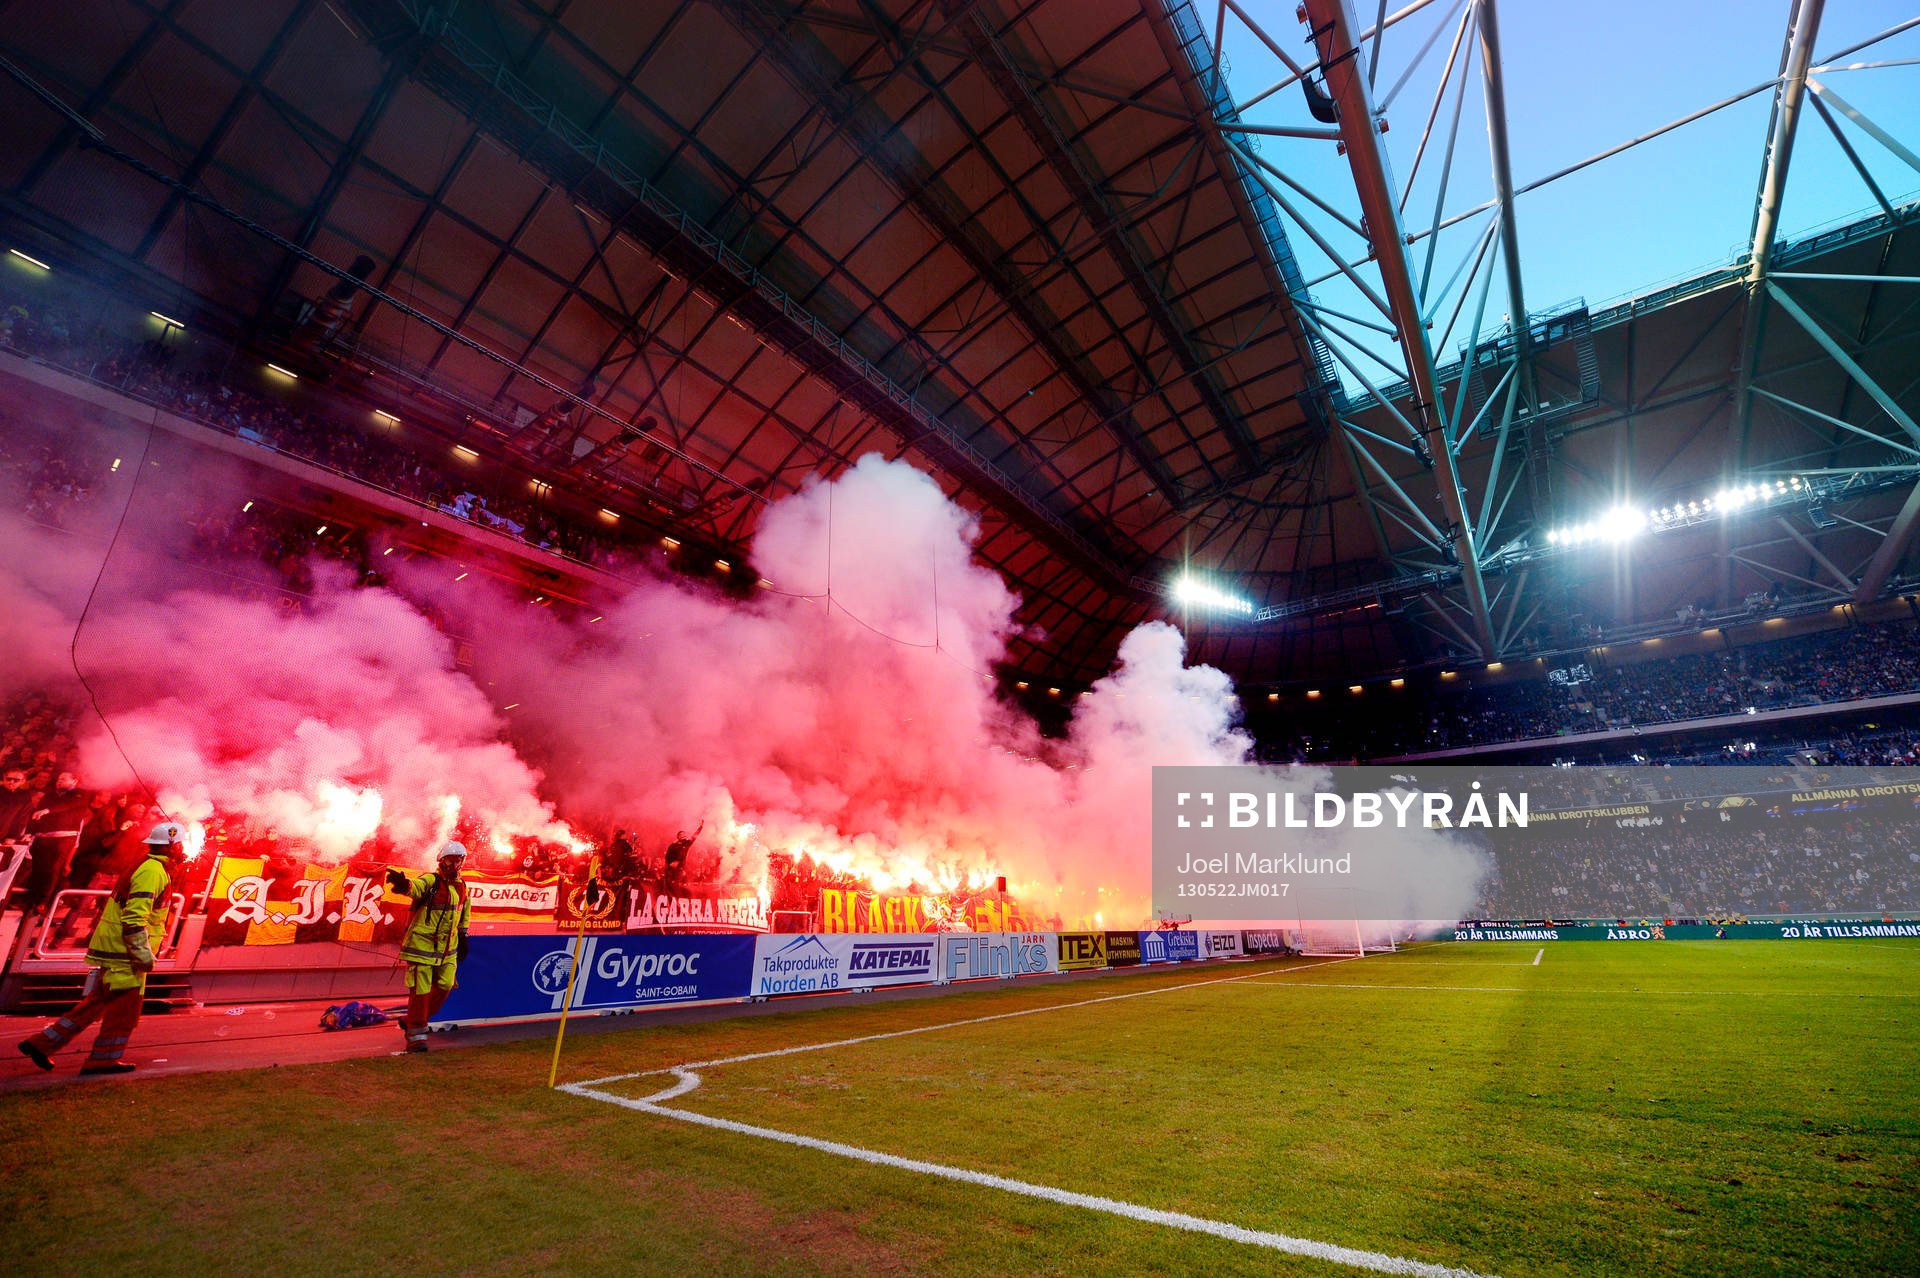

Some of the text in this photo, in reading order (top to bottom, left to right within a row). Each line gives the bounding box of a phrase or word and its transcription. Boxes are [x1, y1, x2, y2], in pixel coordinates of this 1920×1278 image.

[1791, 789, 1859, 802] ALLMÄNNA
[1559, 805, 1649, 820] IDROTTSKLUBBEN
[626, 888, 653, 930] LA
[656, 894, 715, 924] GARRA
[822, 889, 922, 934] BLACK
[559, 920, 591, 928] ALDRG
[1781, 924, 1920, 938] 20 ÅR TILLSAMMANS
[1110, 936, 1135, 946] MASKIN-
[1167, 931, 1195, 947] Grekiska
[1246, 931, 1280, 952] Inspecta
[1455, 929, 1559, 940] 20 ÅR TILLSAMMANS
[1607, 928, 1650, 940] ÅBRO
[1058, 934, 1104, 960] ITEX
[1212, 935, 1235, 951] EIZO
[849, 949, 931, 970] KATEPAL
[946, 936, 1048, 979] Flinks
[1106, 949, 1141, 960] UTHYRNING
[597, 948, 700, 987] Gyproc
[763, 955, 840, 975] Takprodukter
[760, 972, 839, 993] Norden AB
[635, 985, 697, 998] SAINT-GOBAIN
